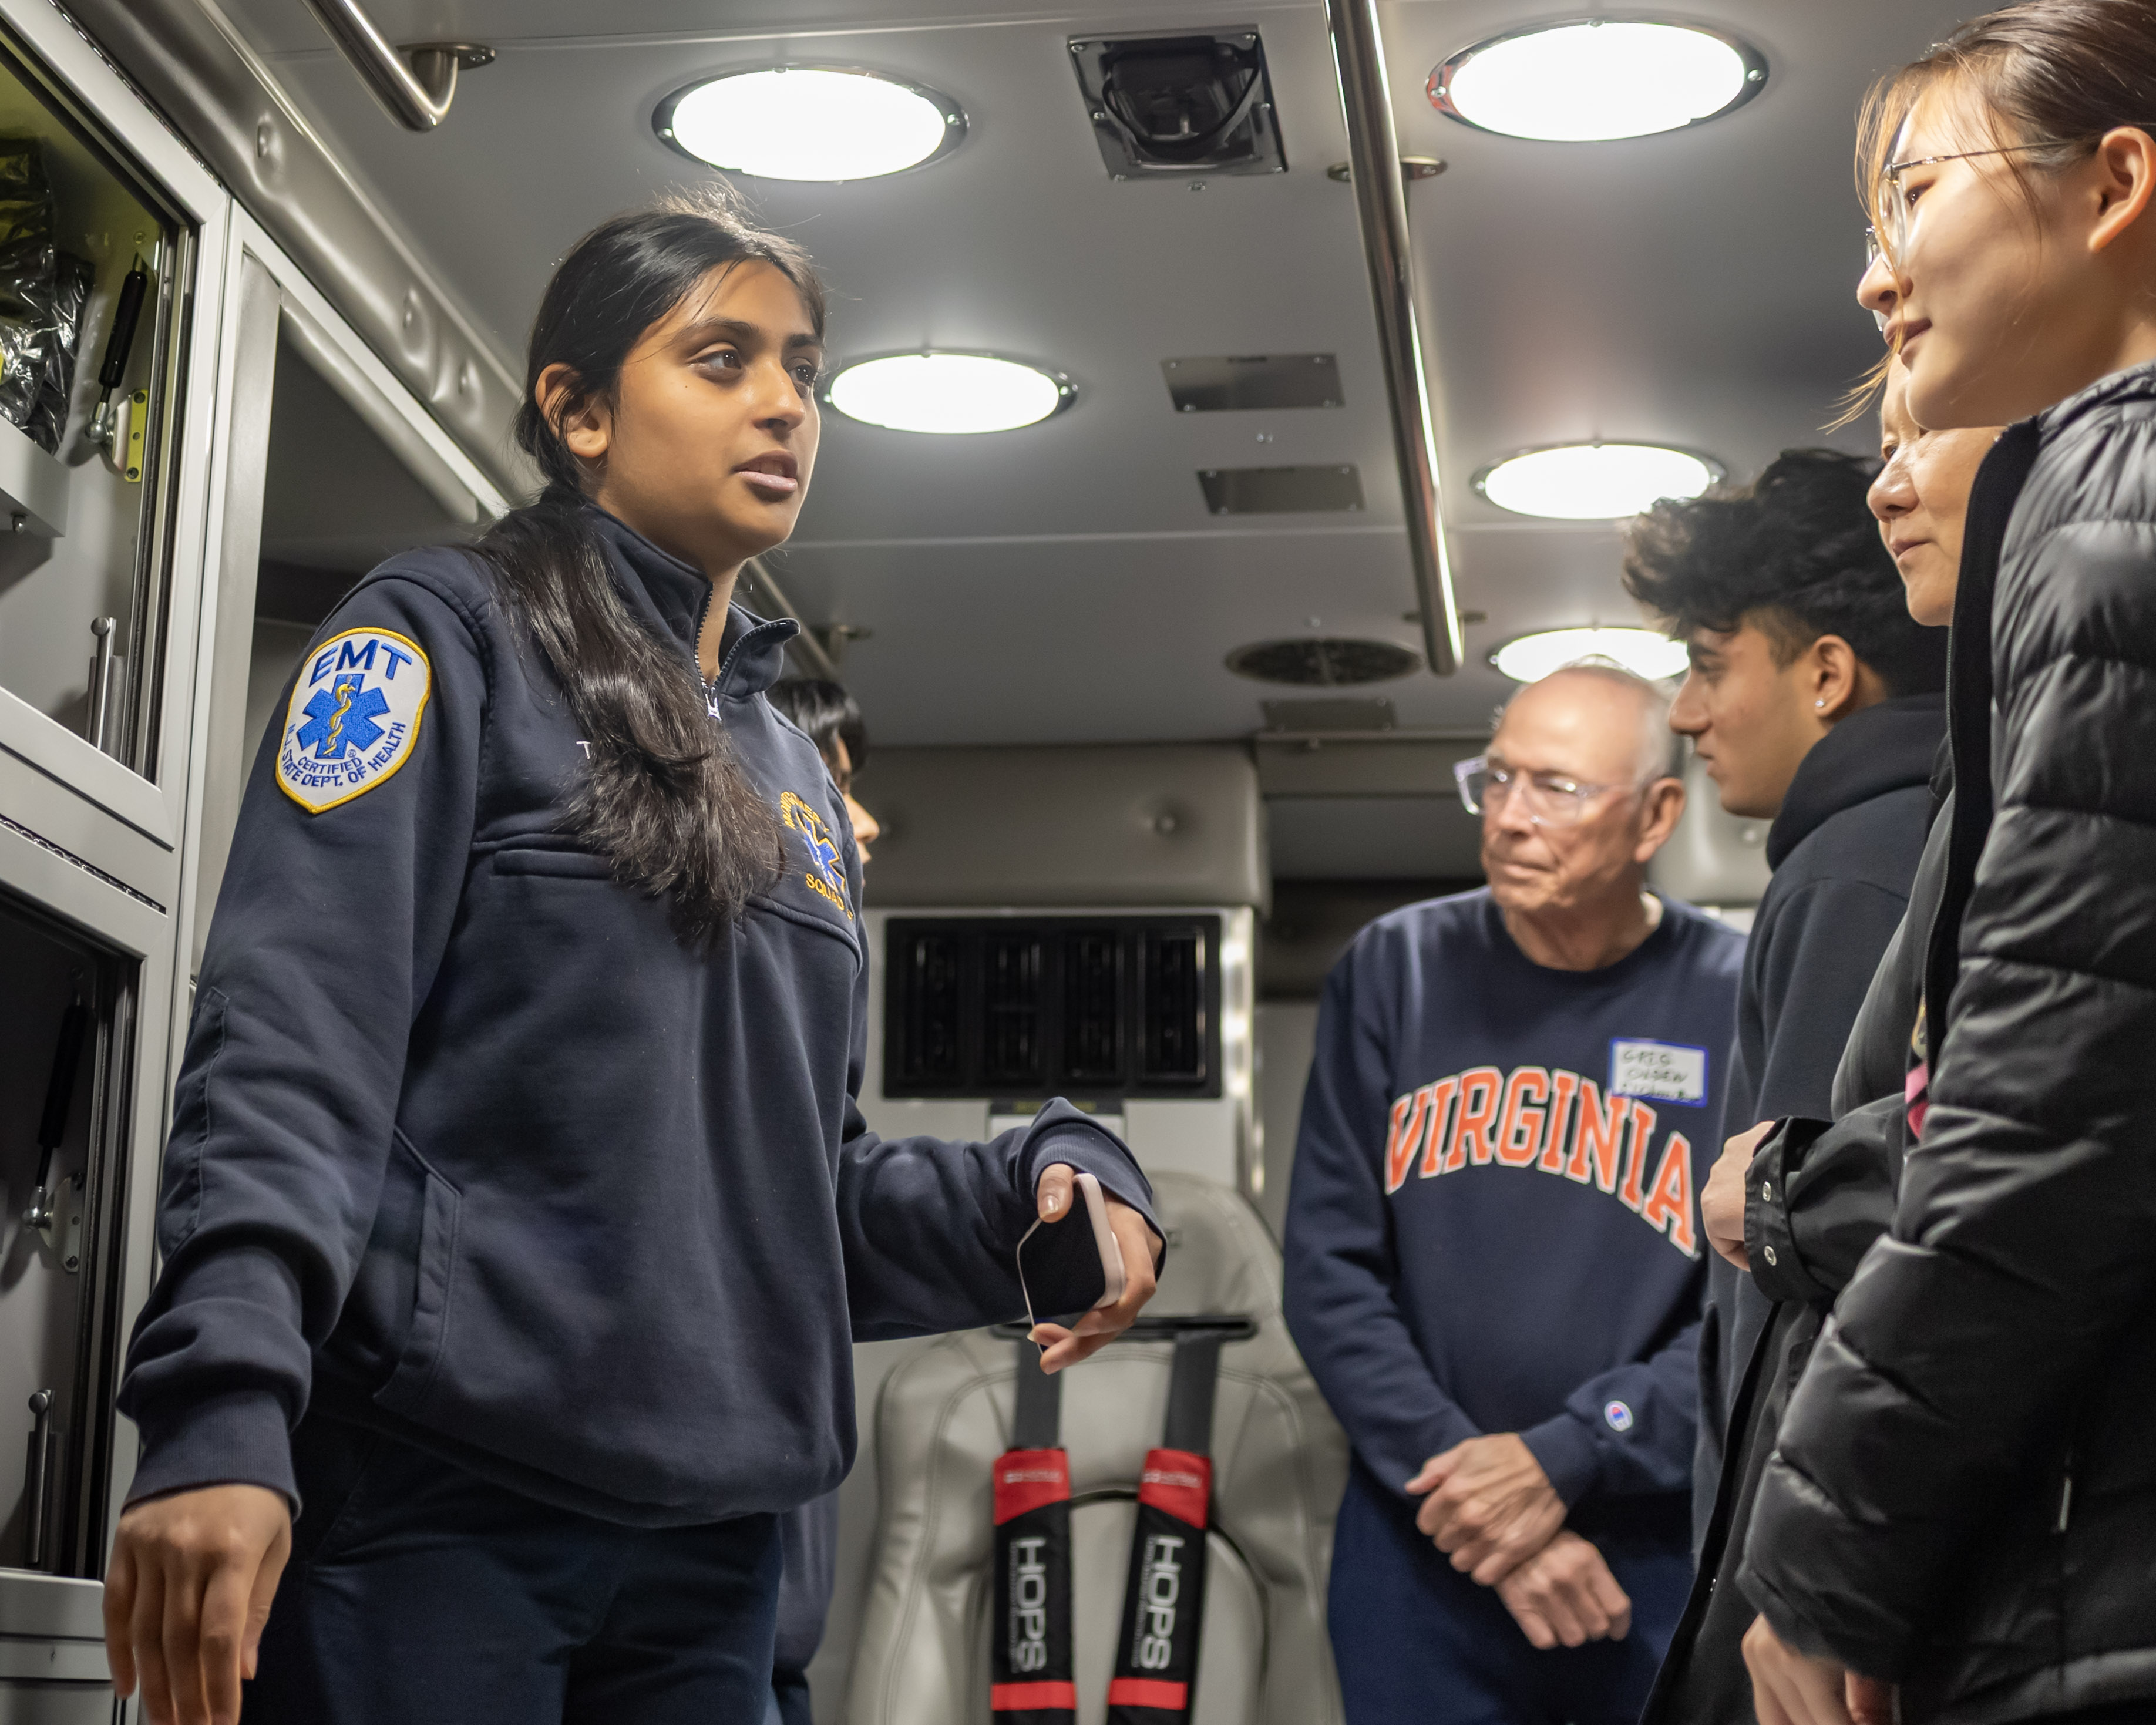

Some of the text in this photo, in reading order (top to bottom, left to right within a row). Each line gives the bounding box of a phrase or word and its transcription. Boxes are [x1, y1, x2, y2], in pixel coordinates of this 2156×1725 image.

[308, 639, 412, 688] EMT
[282, 749, 304, 781] STATE
[301, 773, 344, 788] DEPT.
[348, 766, 367, 783] OF
[368, 721, 406, 771] HEALTH
[298, 756, 363, 774] CERTIFIED
[806, 873, 845, 911] SQUAD
[1384, 1065, 1697, 1257] VIRGINIA
[1016, 1537, 1047, 1672] HOPS
[1139, 1535, 1185, 1670] HOPS
